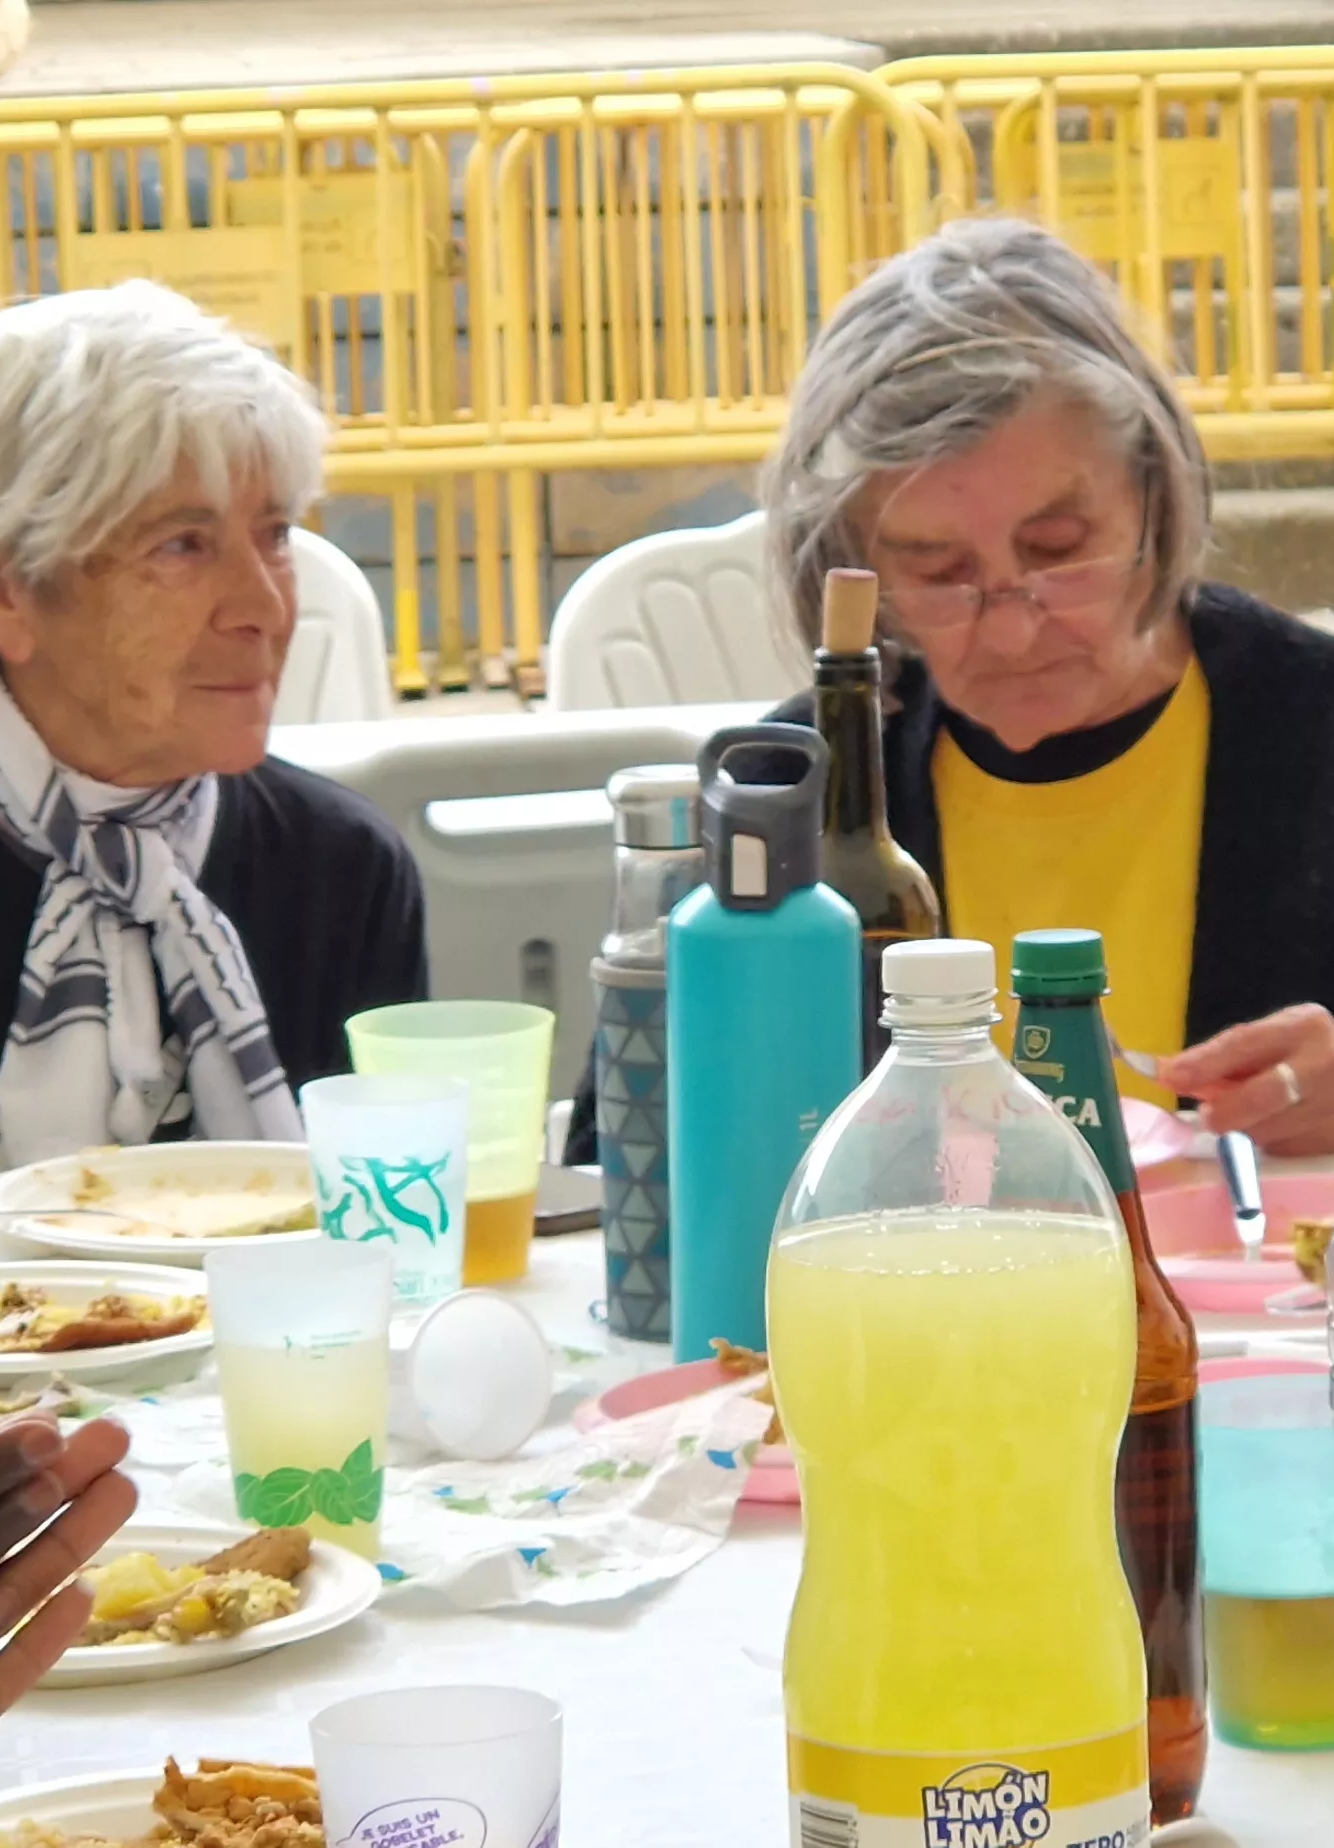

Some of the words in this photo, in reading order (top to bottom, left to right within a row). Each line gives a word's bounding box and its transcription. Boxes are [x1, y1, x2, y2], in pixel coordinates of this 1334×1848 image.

[1047, 1095, 1102, 1127] CA
[923, 1771, 1048, 1819] LIMÓN
[377, 1817, 412, 1836] SUIS
[415, 1807, 441, 1824] UN
